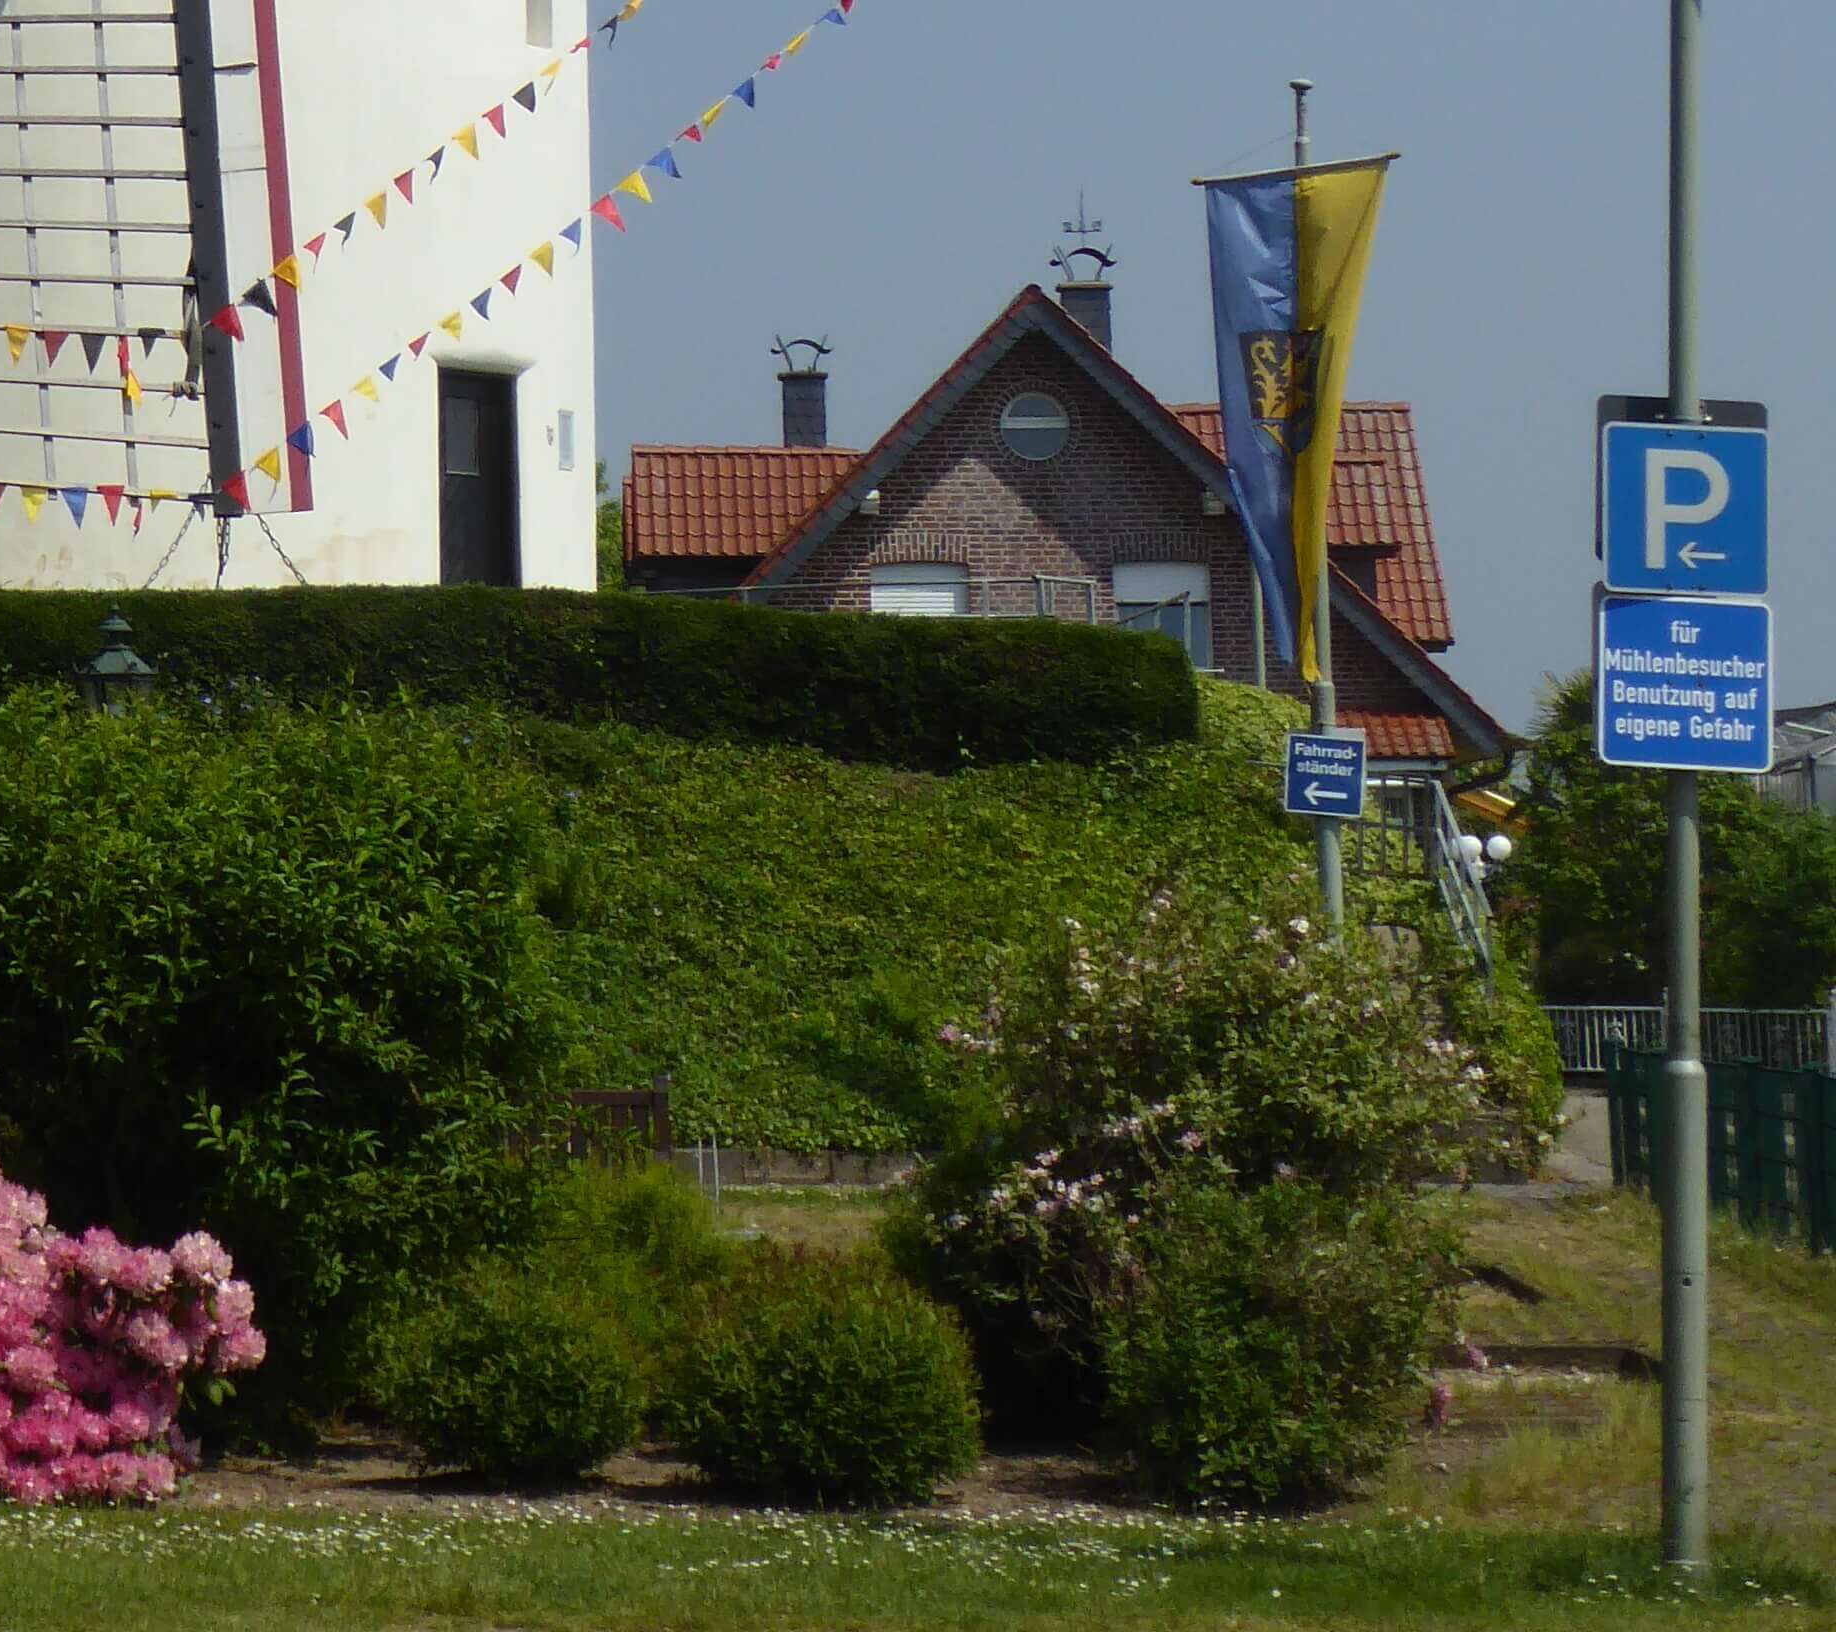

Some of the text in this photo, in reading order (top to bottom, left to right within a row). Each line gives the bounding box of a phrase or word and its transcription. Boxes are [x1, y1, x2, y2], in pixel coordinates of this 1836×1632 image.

[1645, 447, 1731, 570] P
[1670, 619, 1701, 644] für
[1604, 647, 1765, 680] Mühlenbesucher
[1613, 679, 1758, 714] Benutzung auf
[1615, 713, 1756, 742] eigene Gefahr
[1294, 742, 1357, 760] Fahrrad-
[1295, 760, 1356, 777] ständer
